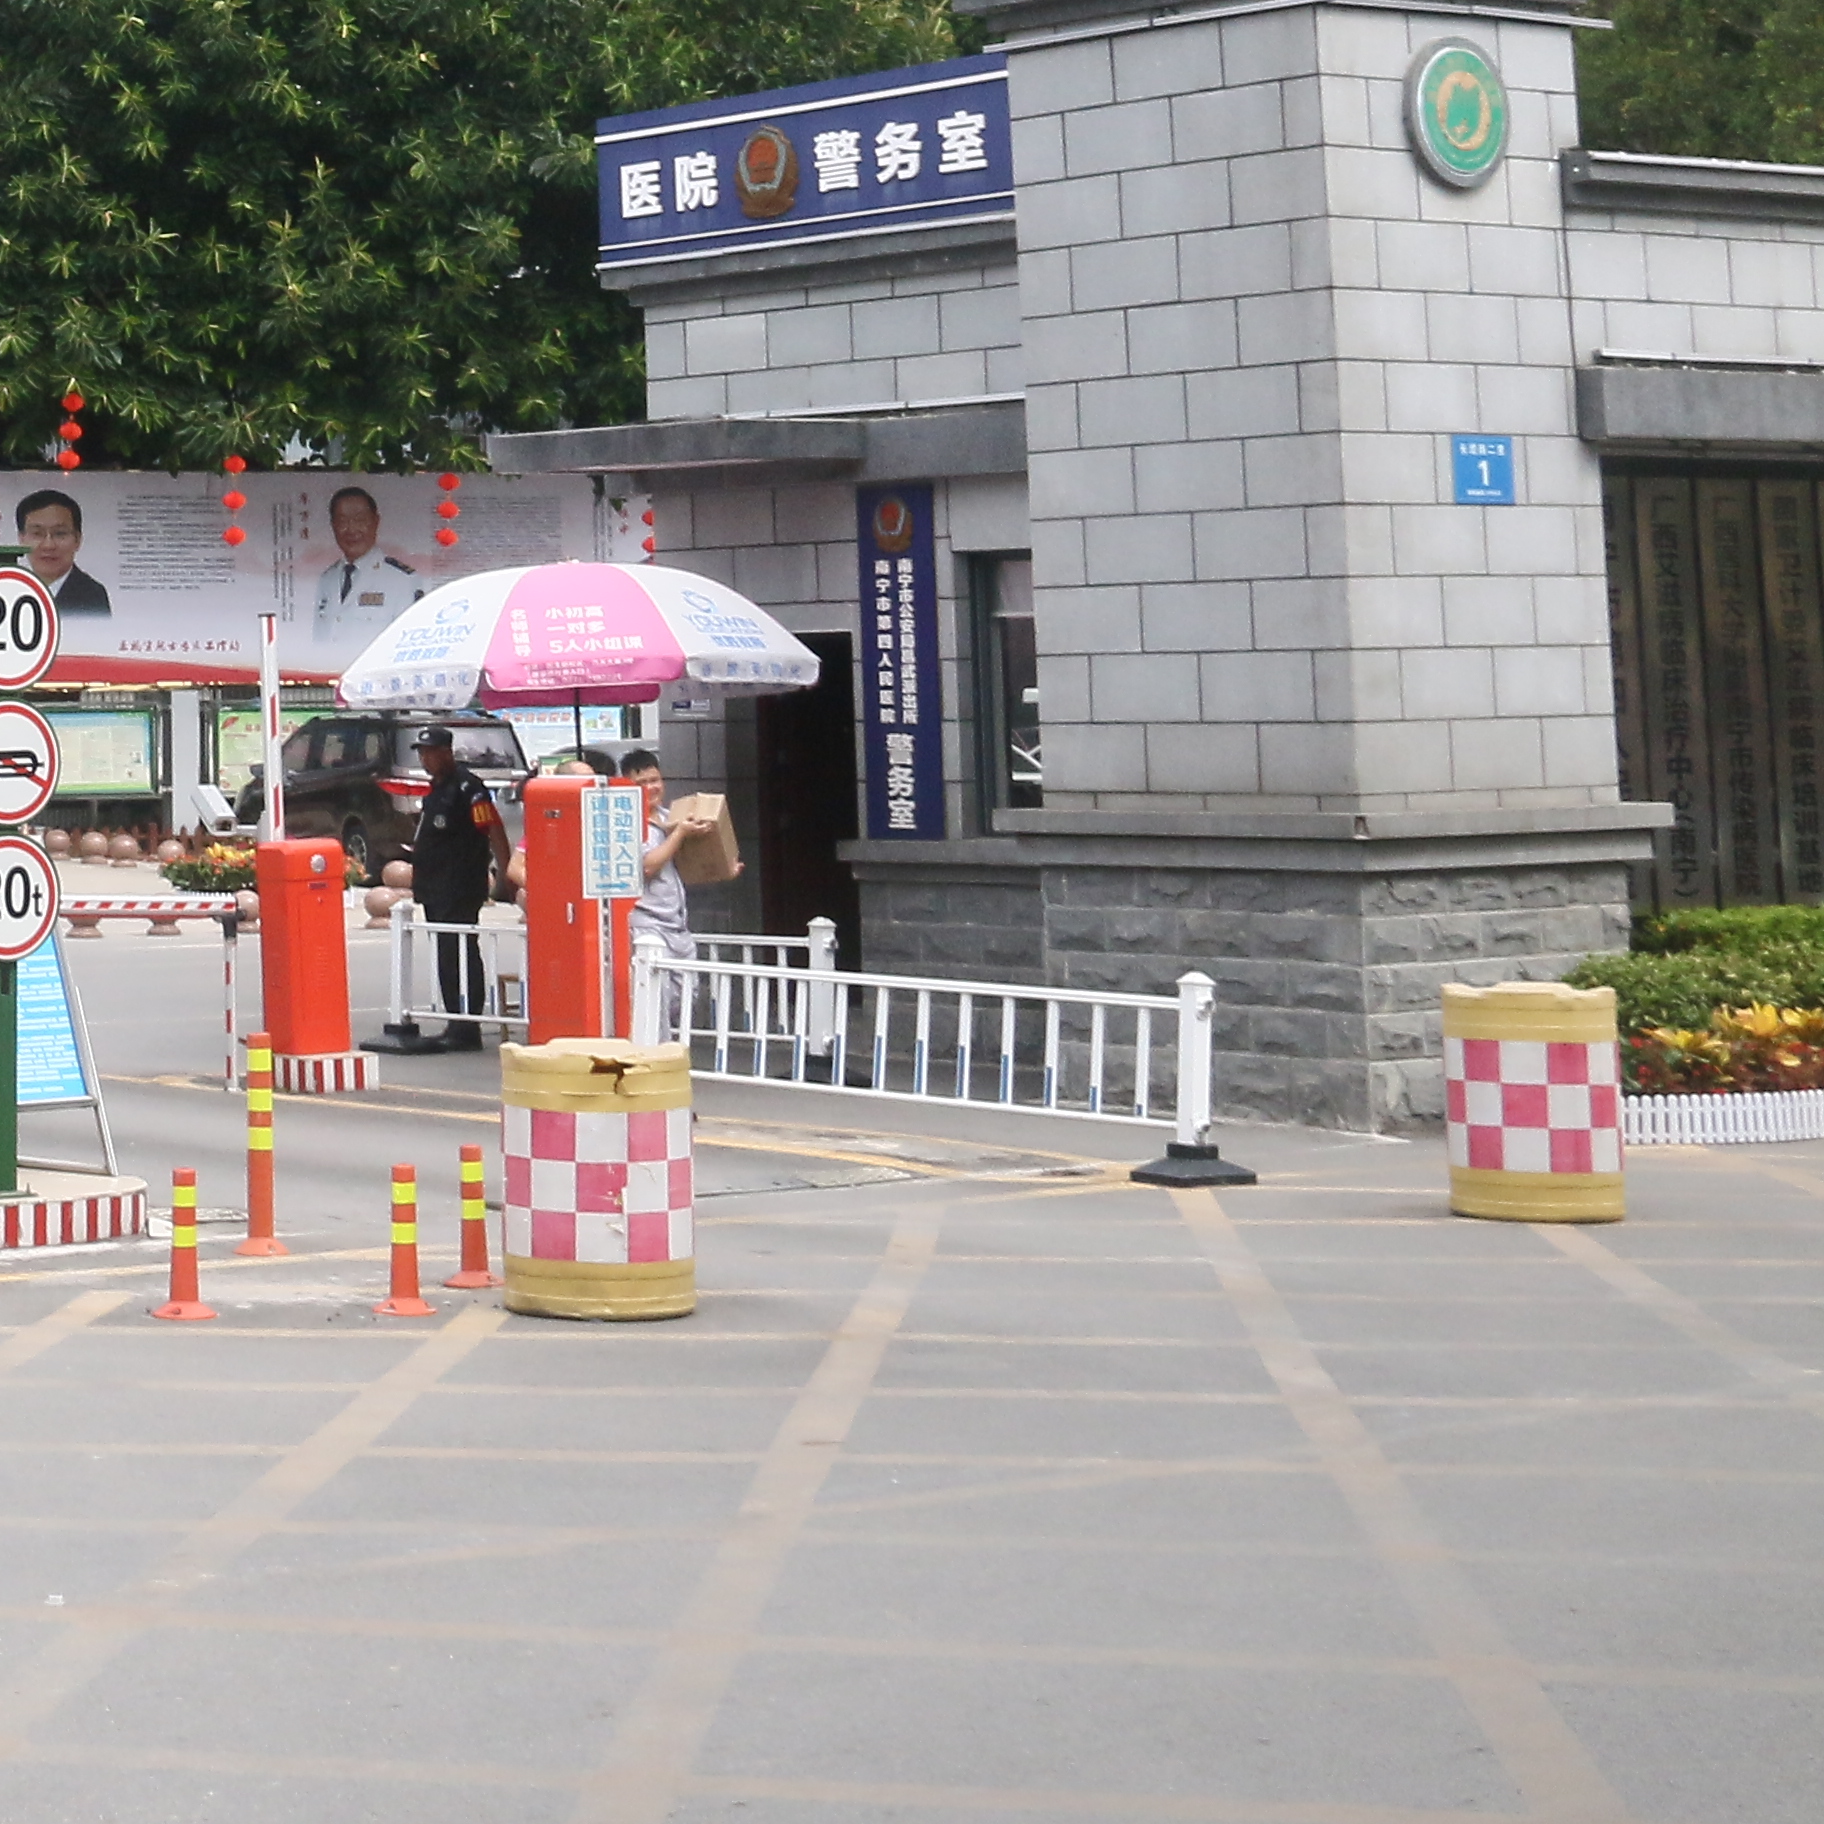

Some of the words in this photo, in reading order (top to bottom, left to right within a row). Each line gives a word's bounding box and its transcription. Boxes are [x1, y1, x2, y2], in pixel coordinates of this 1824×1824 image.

[619, 151, 720, 219] 医院
[813, 110, 989, 194] 警务室
[1478, 460, 1490, 487] 1
[545, 605, 605, 619] 小初高
[546, 621, 606, 634] 一对多
[549, 635, 644, 654] 5人小组课
[874, 559, 897, 724] 南宁市第四人民医院
[885, 732, 917, 830] 警务室
[614, 796, 634, 877] 电动车入口
